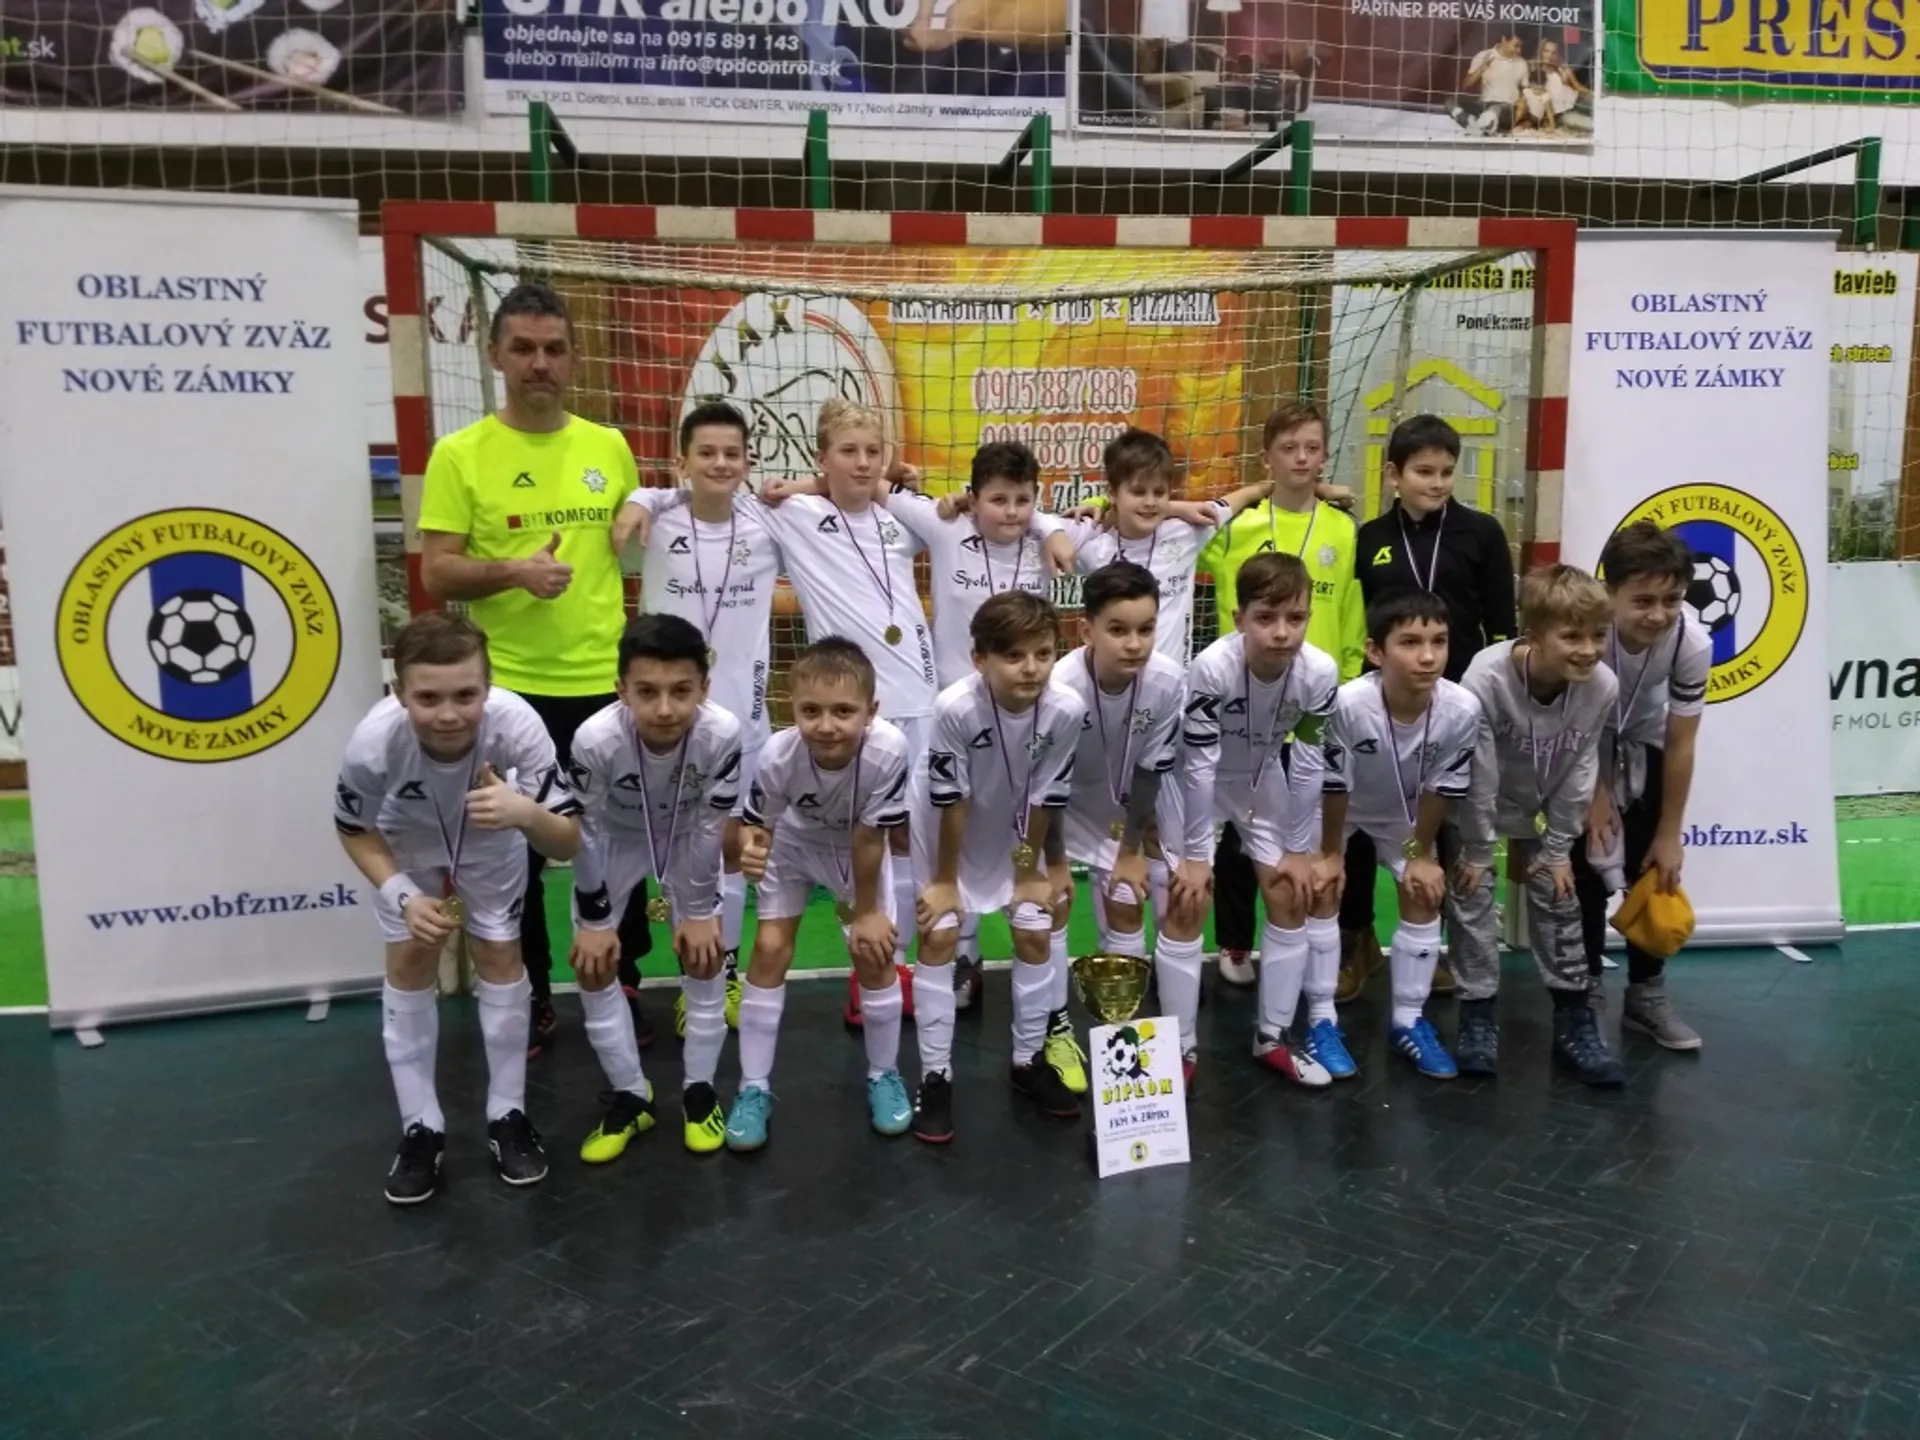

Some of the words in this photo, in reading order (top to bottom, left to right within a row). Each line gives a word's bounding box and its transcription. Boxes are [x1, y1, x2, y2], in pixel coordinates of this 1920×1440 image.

[1351, 1, 1423, 19] PARTNER
[1428, 2, 1460, 19] PRE
[1500, 4, 1580, 24] KOMFORT
[503, 24, 608, 46] objednajte
[613, 31, 635, 45] sa
[640, 33, 662, 46] na
[667, 30, 717, 48] 0915
[721, 32, 757, 50] 891
[764, 35, 799, 51] 143
[1680, 0, 1920, 61] PRES
[504, 48, 557, 67] alebo
[560, 50, 629, 69] mailom
[633, 56, 657, 70] na
[660, 54, 842, 77] info@tpdcontrol.sk
[77, 272, 267, 302] OBLASTNÝ
[1631, 289, 1768, 313] OBLASTNÝ
[16, 318, 235, 348] FUTBALOVÝ
[245, 320, 332, 349] ZVÄZ
[1586, 327, 1741, 351] FUTBALOVÝ
[1749, 326, 1813, 351] ZVÄZ
[62, 363, 164, 393] NOVÉ
[173, 363, 295, 394] ZÁMKY
[1616, 364, 1688, 389] NOVÉ
[1695, 364, 1786, 388] ZÁMKY
[1671, 495, 1779, 543] FUTBALOVÝ
[1771, 543, 1799, 595] ZVÄZ
[72, 530, 148, 644] OBLASTNÝ
[152, 522, 296, 577] FUTBALOVÝ
[290, 578, 324, 636] ZVÄZ
[1705, 655, 1764, 693] ÁMKY
[128, 713, 200, 750] NOVÉ
[204, 705, 289, 751] ZÁMKY
[1849, 711, 1892, 731] MOL
[87, 883, 359, 930] www.obfznz.sk
[1102, 1078, 1173, 1106] DIPLOM
